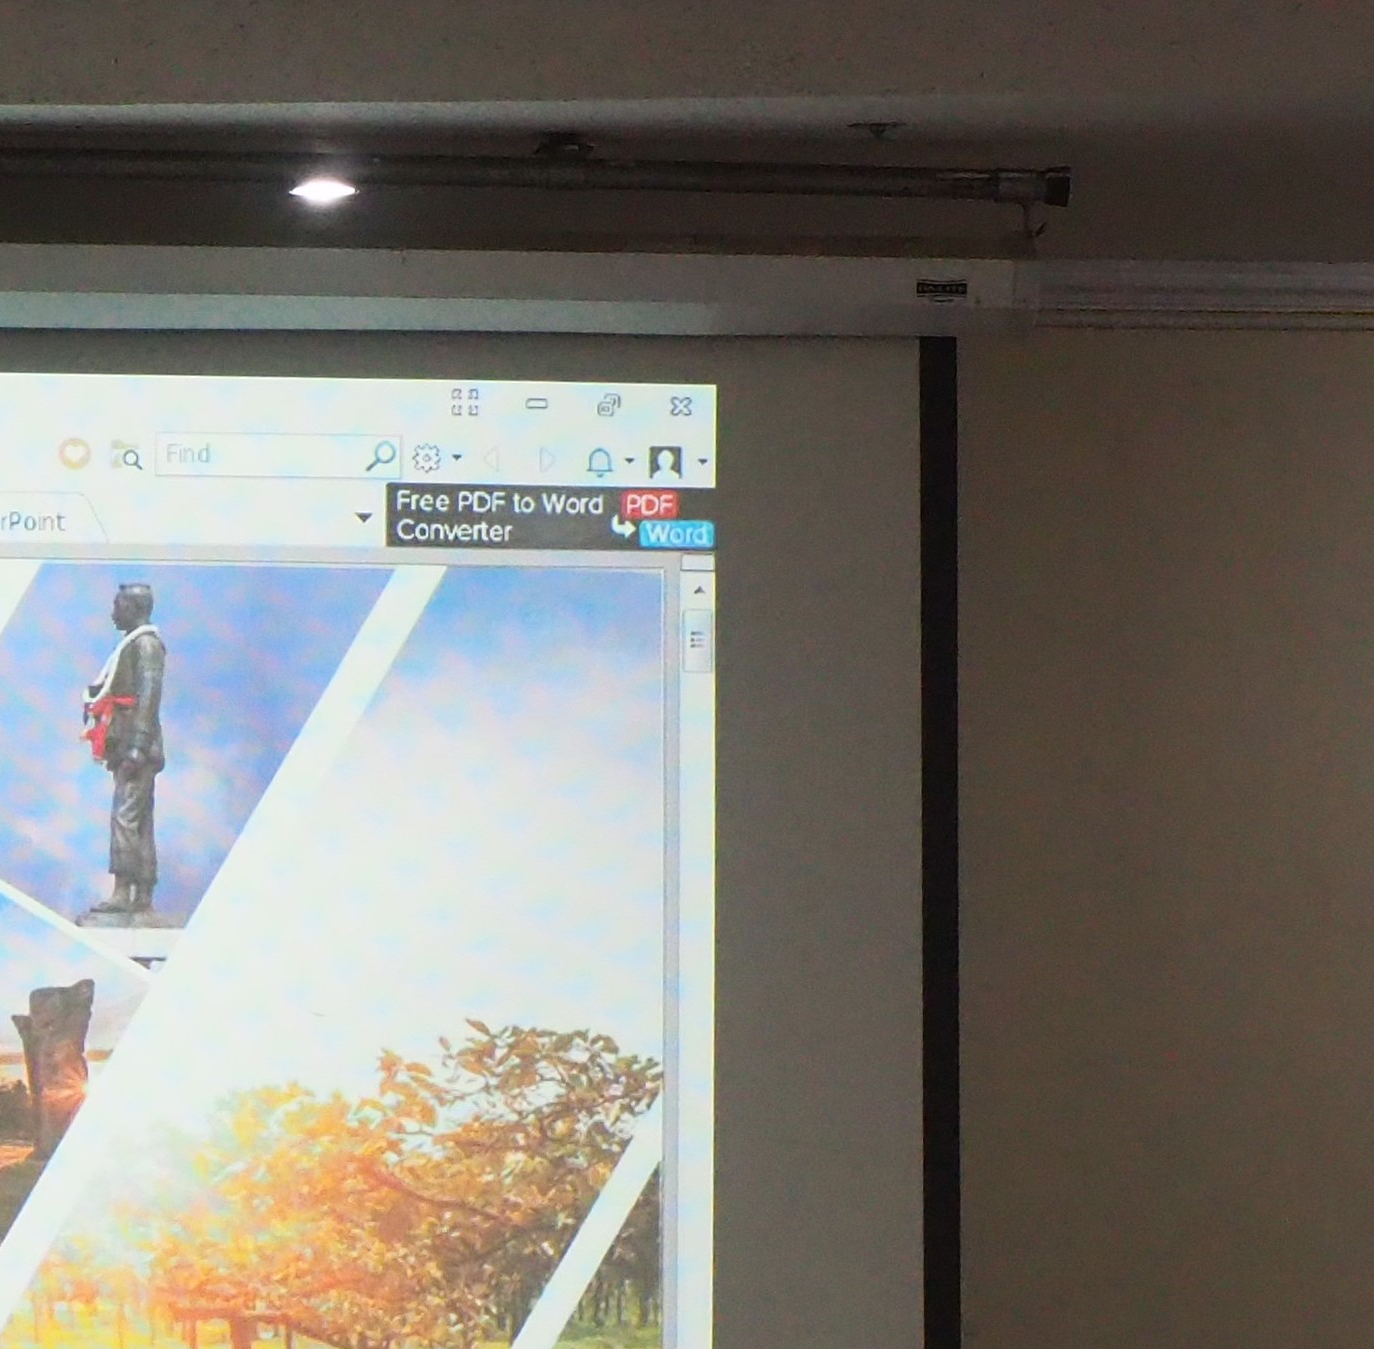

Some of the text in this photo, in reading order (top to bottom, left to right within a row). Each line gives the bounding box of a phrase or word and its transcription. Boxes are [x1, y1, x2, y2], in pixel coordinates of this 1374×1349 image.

[166, 442, 212, 464] Find
[396, 489, 604, 515] Free PDF to Word
[626, 493, 674, 516] PDF
[396, 518, 513, 542] Converter
[646, 521, 710, 546] Word
